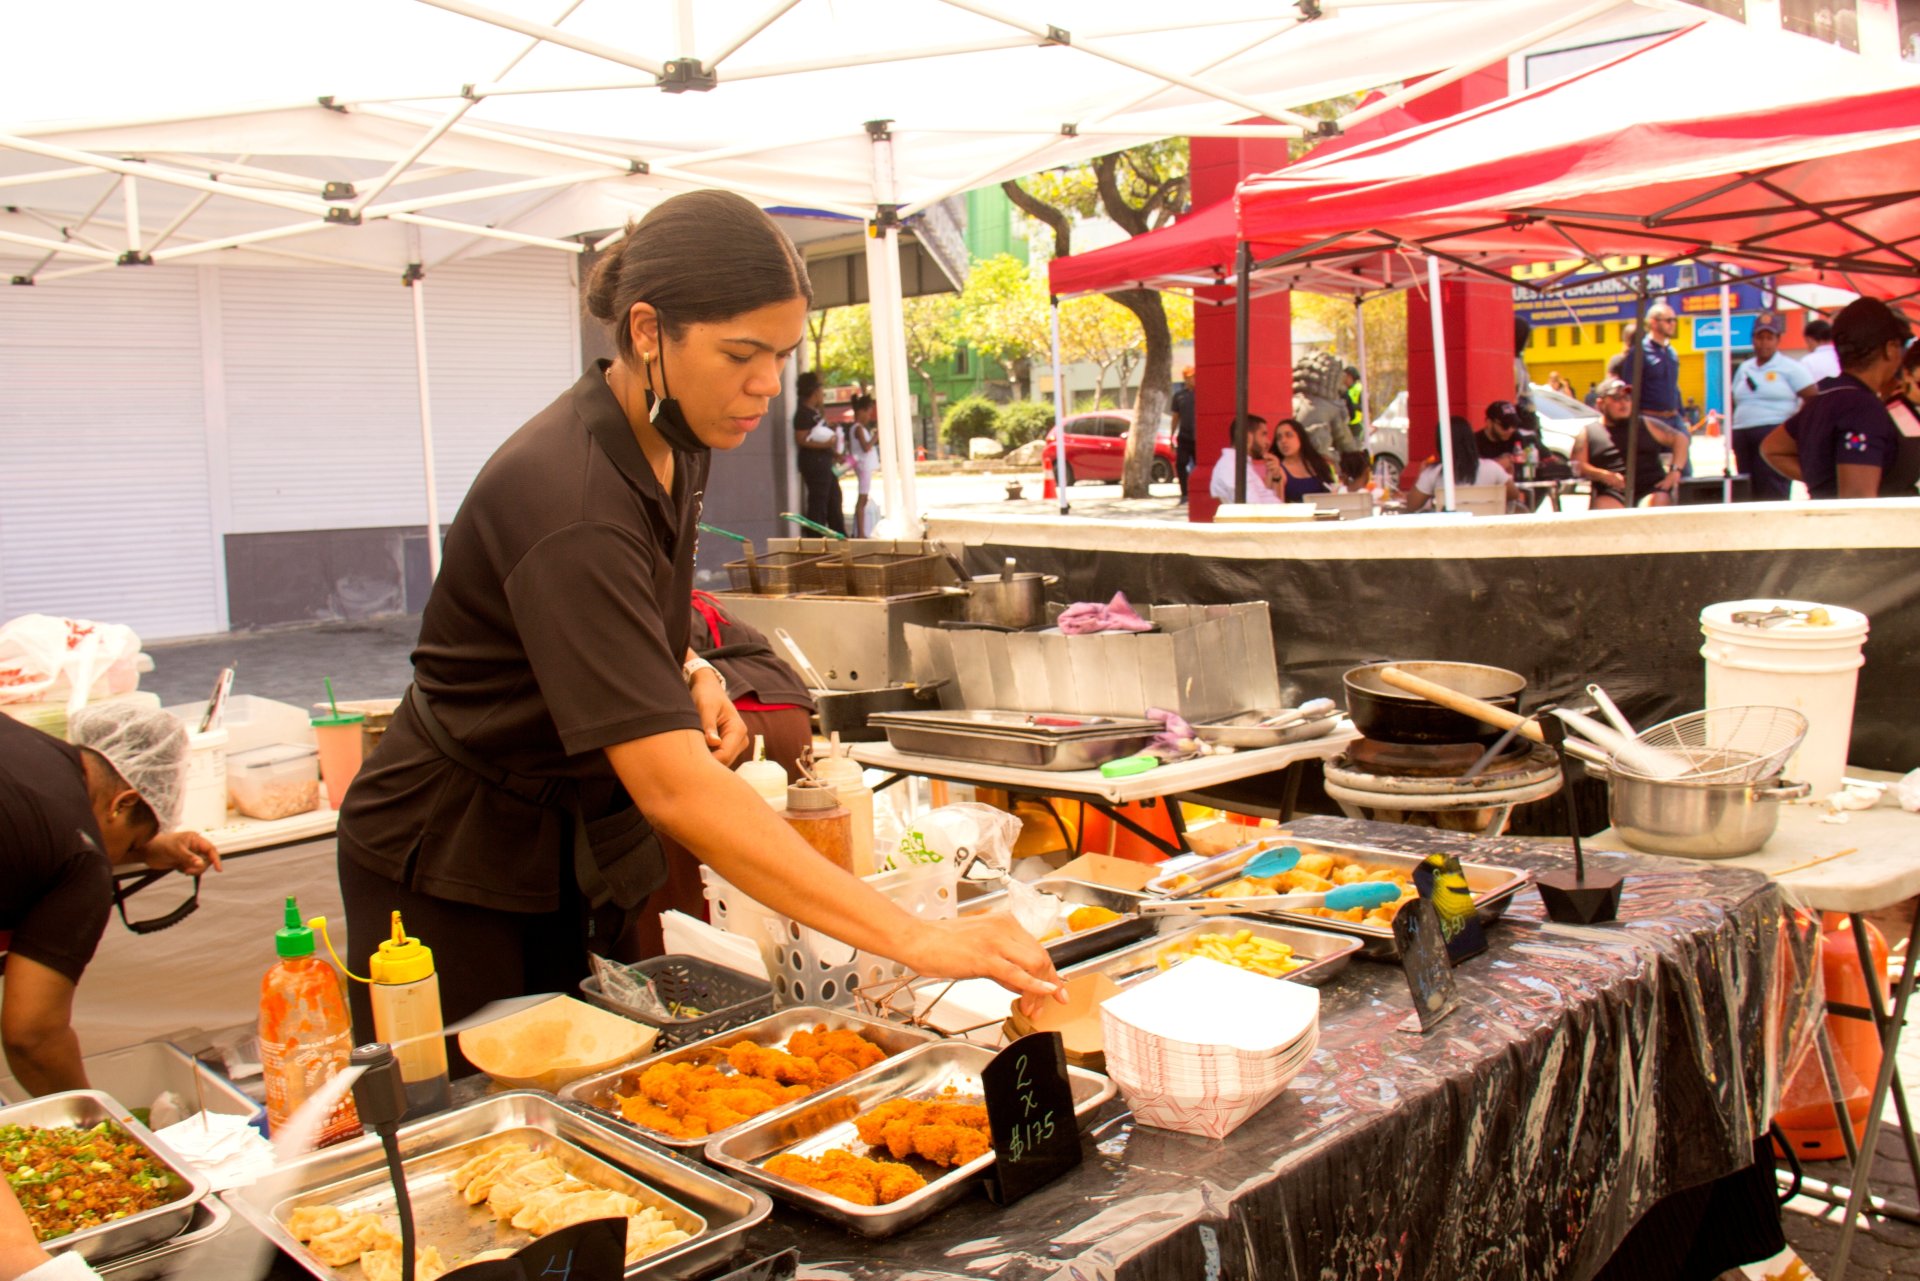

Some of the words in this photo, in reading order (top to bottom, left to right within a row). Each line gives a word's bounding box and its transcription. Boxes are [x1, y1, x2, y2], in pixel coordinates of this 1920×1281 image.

[1567, 274, 1664, 297] ENCARNACON
[1016, 1054, 1032, 1090] 2
[1009, 1110, 1055, 1163] $175
[541, 1248, 574, 1281] 4
